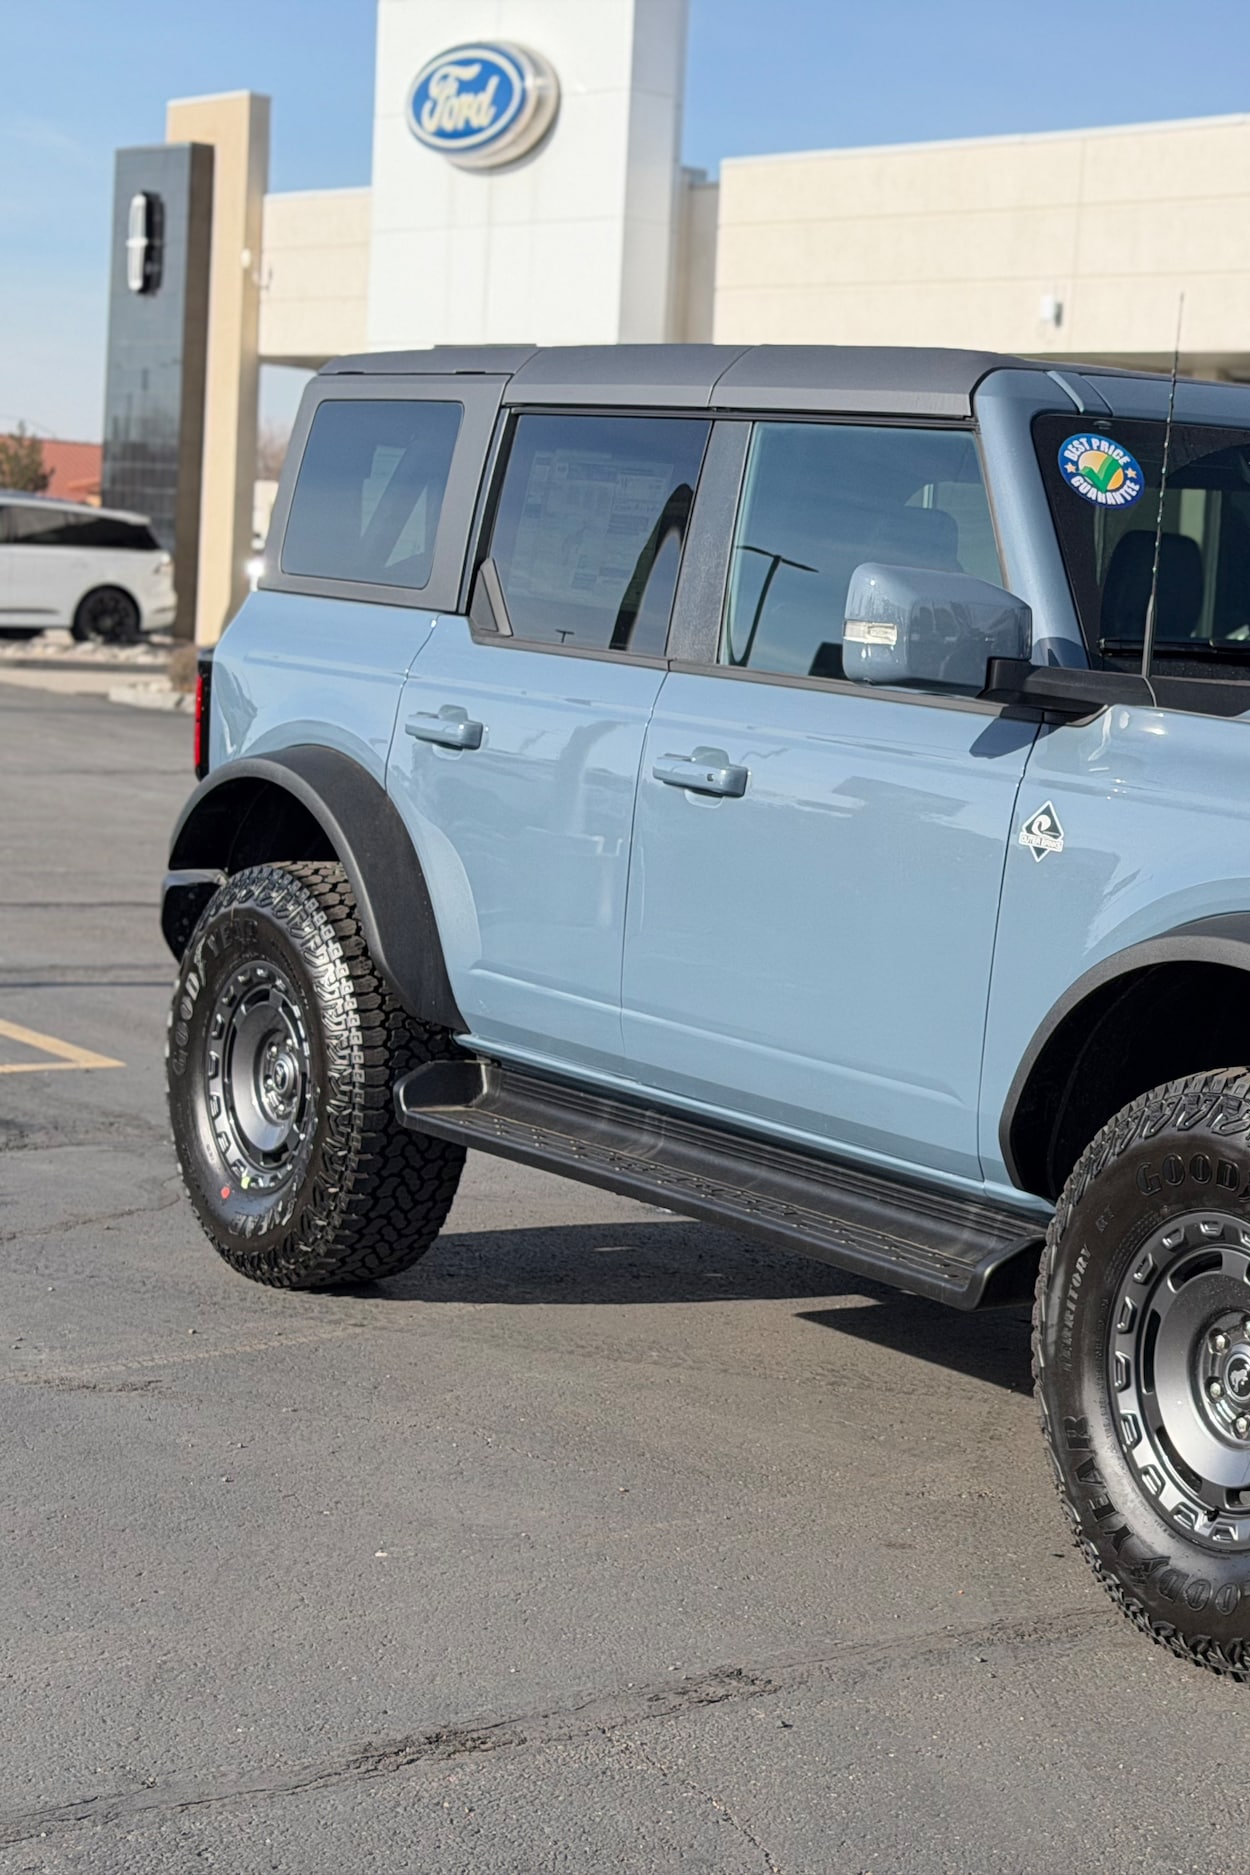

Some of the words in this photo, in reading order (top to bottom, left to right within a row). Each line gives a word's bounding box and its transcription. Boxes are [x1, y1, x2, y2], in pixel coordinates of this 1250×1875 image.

[420, 62, 501, 134] Ford
[1063, 437, 1092, 462] BEST
[1091, 437, 1131, 466] PRICE
[1070, 475, 1141, 505] GUARANTEE
